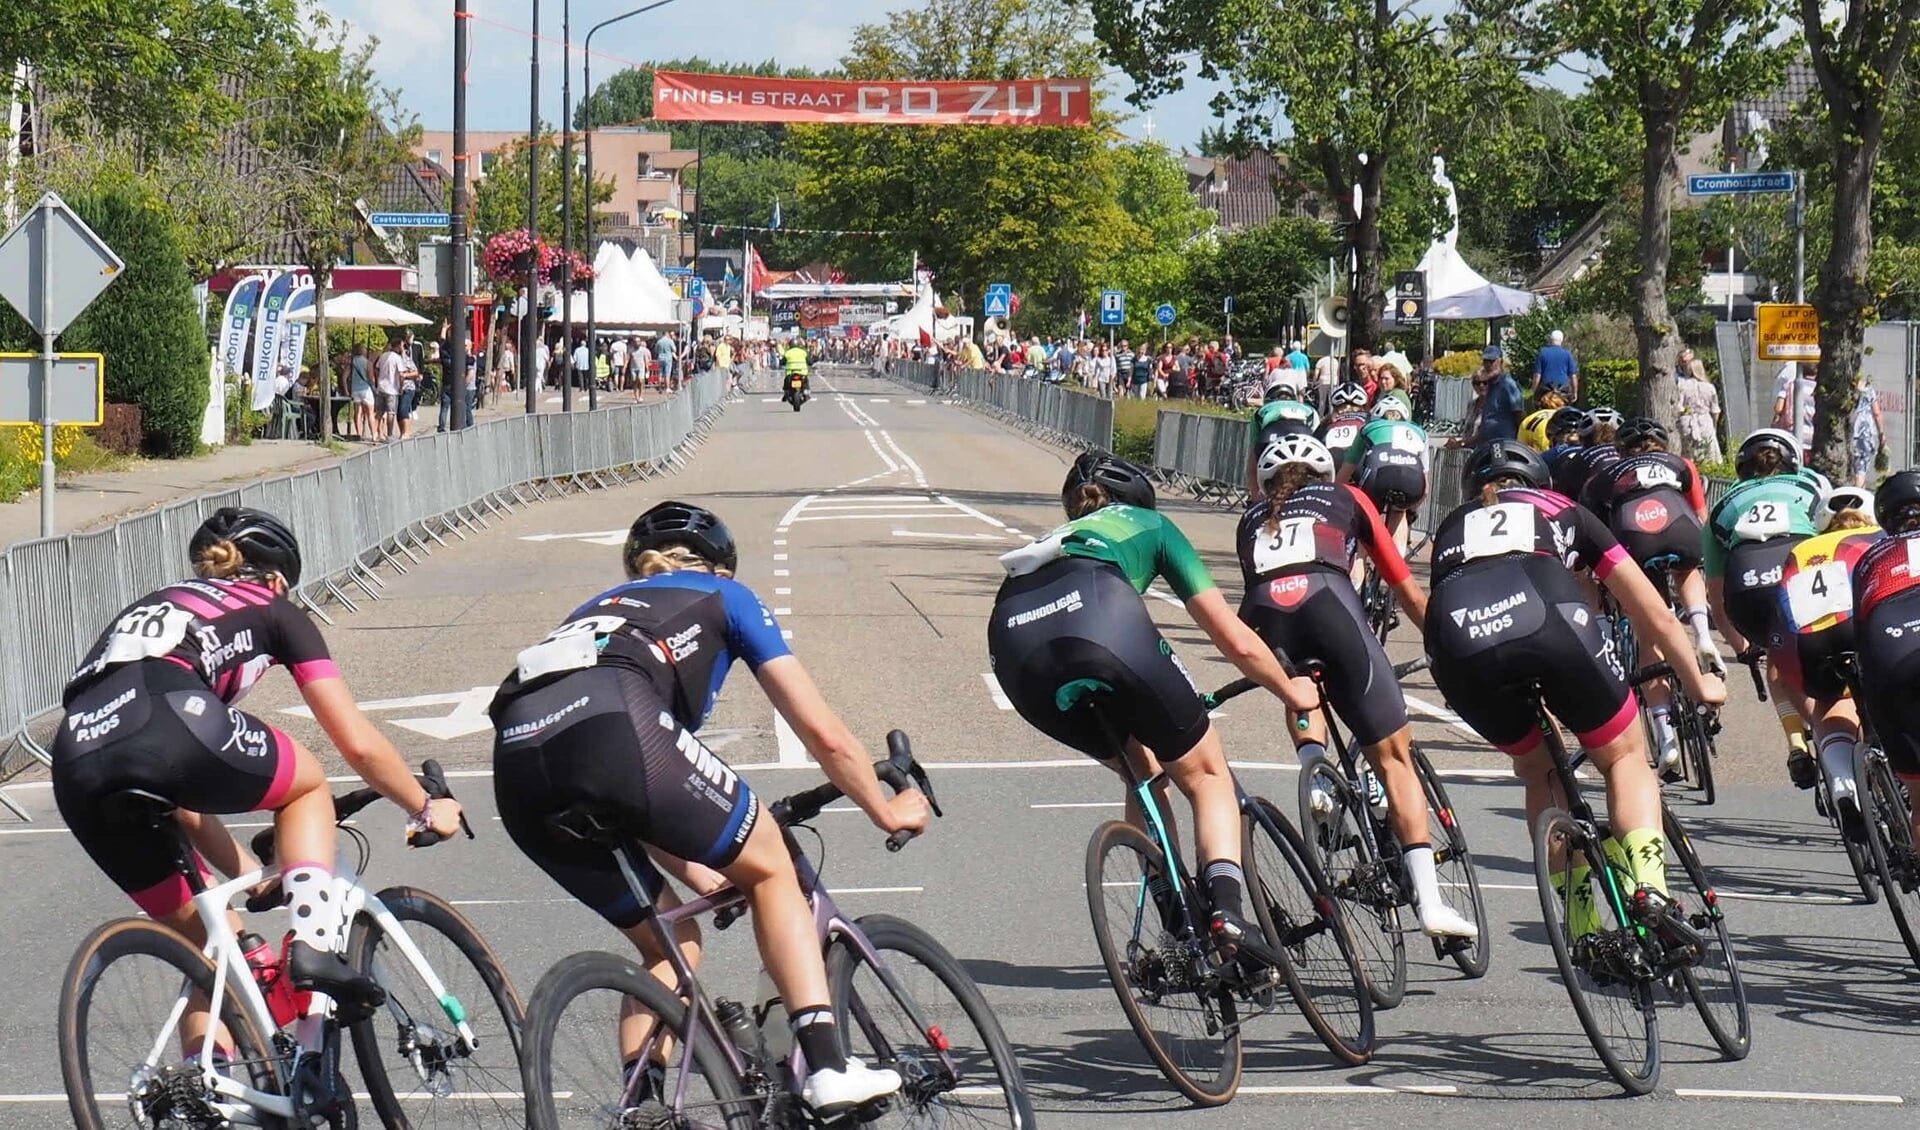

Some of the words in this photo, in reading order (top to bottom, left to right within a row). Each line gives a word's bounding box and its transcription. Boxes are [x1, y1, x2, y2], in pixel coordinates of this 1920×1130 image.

[658, 88, 743, 105] FINISH
[751, 91, 845, 107] STRAAT
[857, 86, 938, 116] CO
[967, 85, 1081, 117] ZUT
[1695, 177, 1785, 190] Cromhoutstraat
[1782, 310, 1799, 318] LET
[1784, 321, 1816, 330] UITRIT
[1763, 333, 1818, 342] BOUWVERK
[1334, 427, 1350, 439] 39
[1405, 429, 1413, 441] 6
[1490, 509, 1508, 537] 2
[1635, 506, 1668, 522] hicle
[1748, 504, 1777, 524] 32
[1269, 522, 1300, 551] 37
[1270, 576, 1309, 594] hicle
[1760, 565, 1783, 585] sti
[1811, 569, 1828, 598] 4
[1007, 590, 1081, 629] #WAHOOLIGAN
[1467, 591, 1527, 622] VLASMAN
[666, 623, 703, 649] Osborne
[1468, 614, 1514, 639] P.VOS
[672, 640, 700, 662] Clarke
[76, 714, 121, 743] P.VOS
